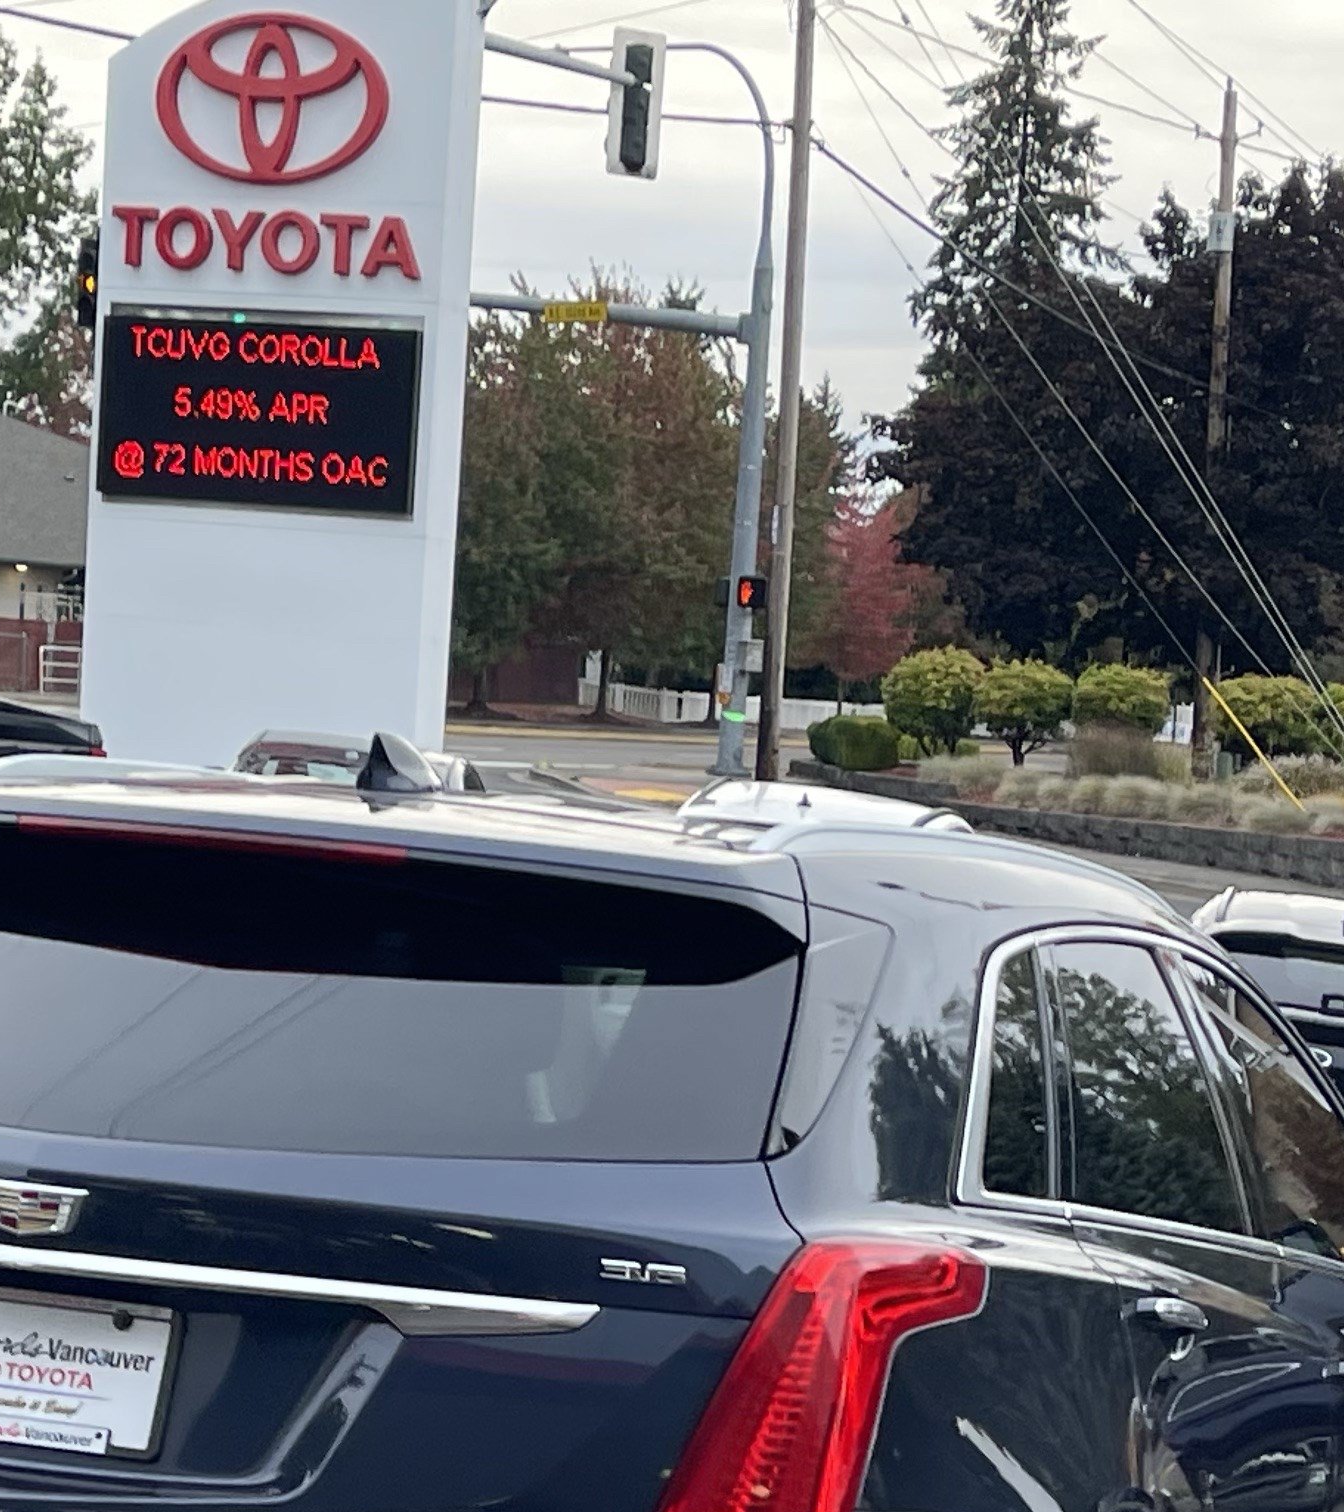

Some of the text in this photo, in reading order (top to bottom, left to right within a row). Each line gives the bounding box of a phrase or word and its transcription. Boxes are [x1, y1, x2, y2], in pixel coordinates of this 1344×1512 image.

[113, 206, 421, 281] TOYOTA
[130, 324, 381, 370] TCUVG COROLLA
[172, 383, 330, 426] 5.49% APR
[113, 440, 390, 488] @ 72 MONTHS OAC
[6, 1361, 94, 1391] TOYOTA
[48, 1336, 156, 1373] Vancouver
[24, 1426, 94, 1447] Vancouver
